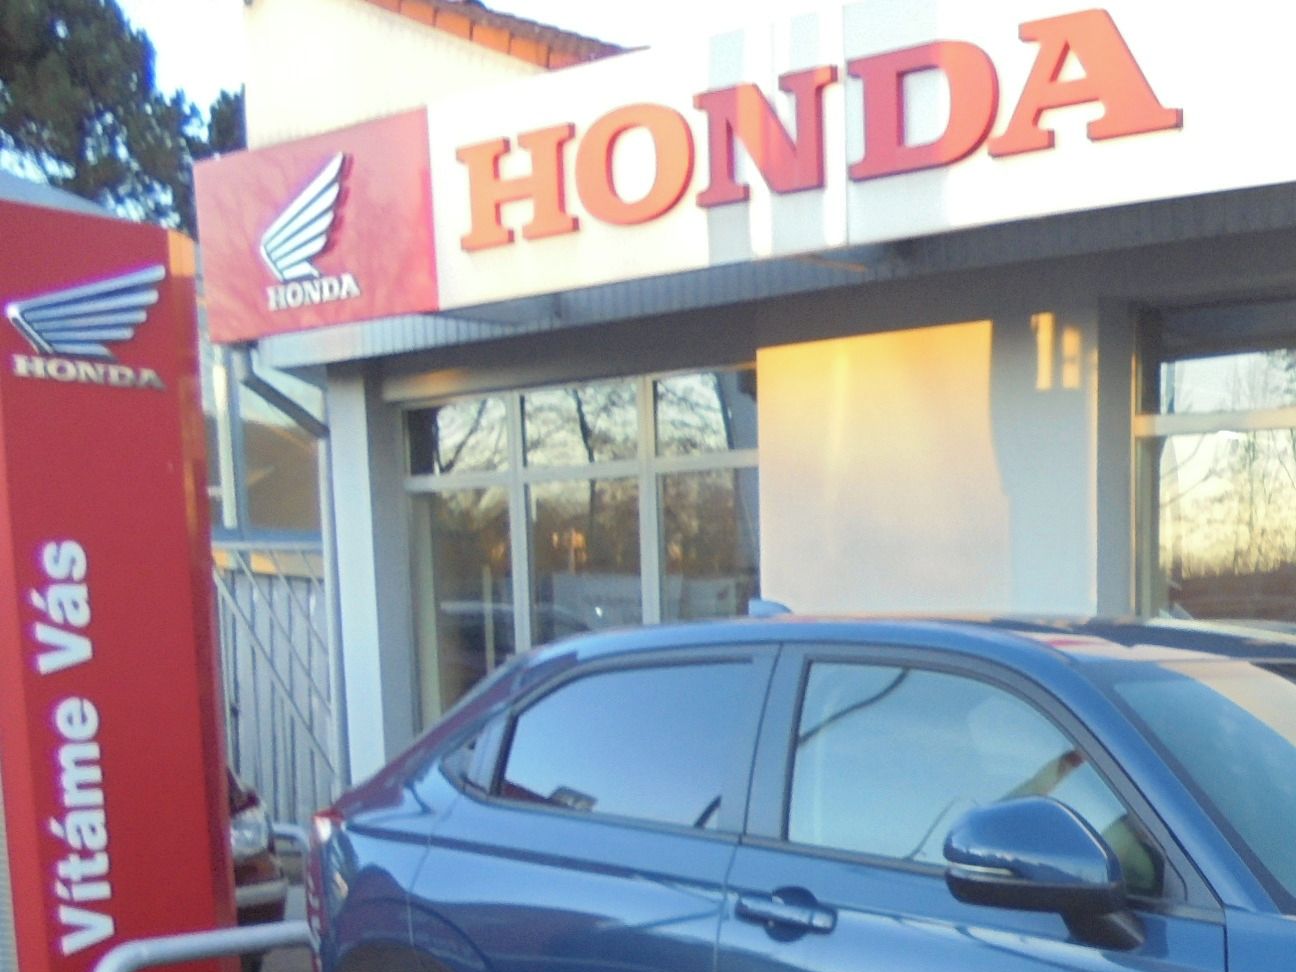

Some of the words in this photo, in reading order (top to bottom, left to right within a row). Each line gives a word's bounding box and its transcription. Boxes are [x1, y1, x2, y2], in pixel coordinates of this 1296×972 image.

[456, 8, 1184, 252] HONDA
[266, 272, 362, 312] HONDA
[12, 353, 166, 391] HONDA
[30, 538, 94, 676] Vás
[49, 695, 116, 957] Vítáme
